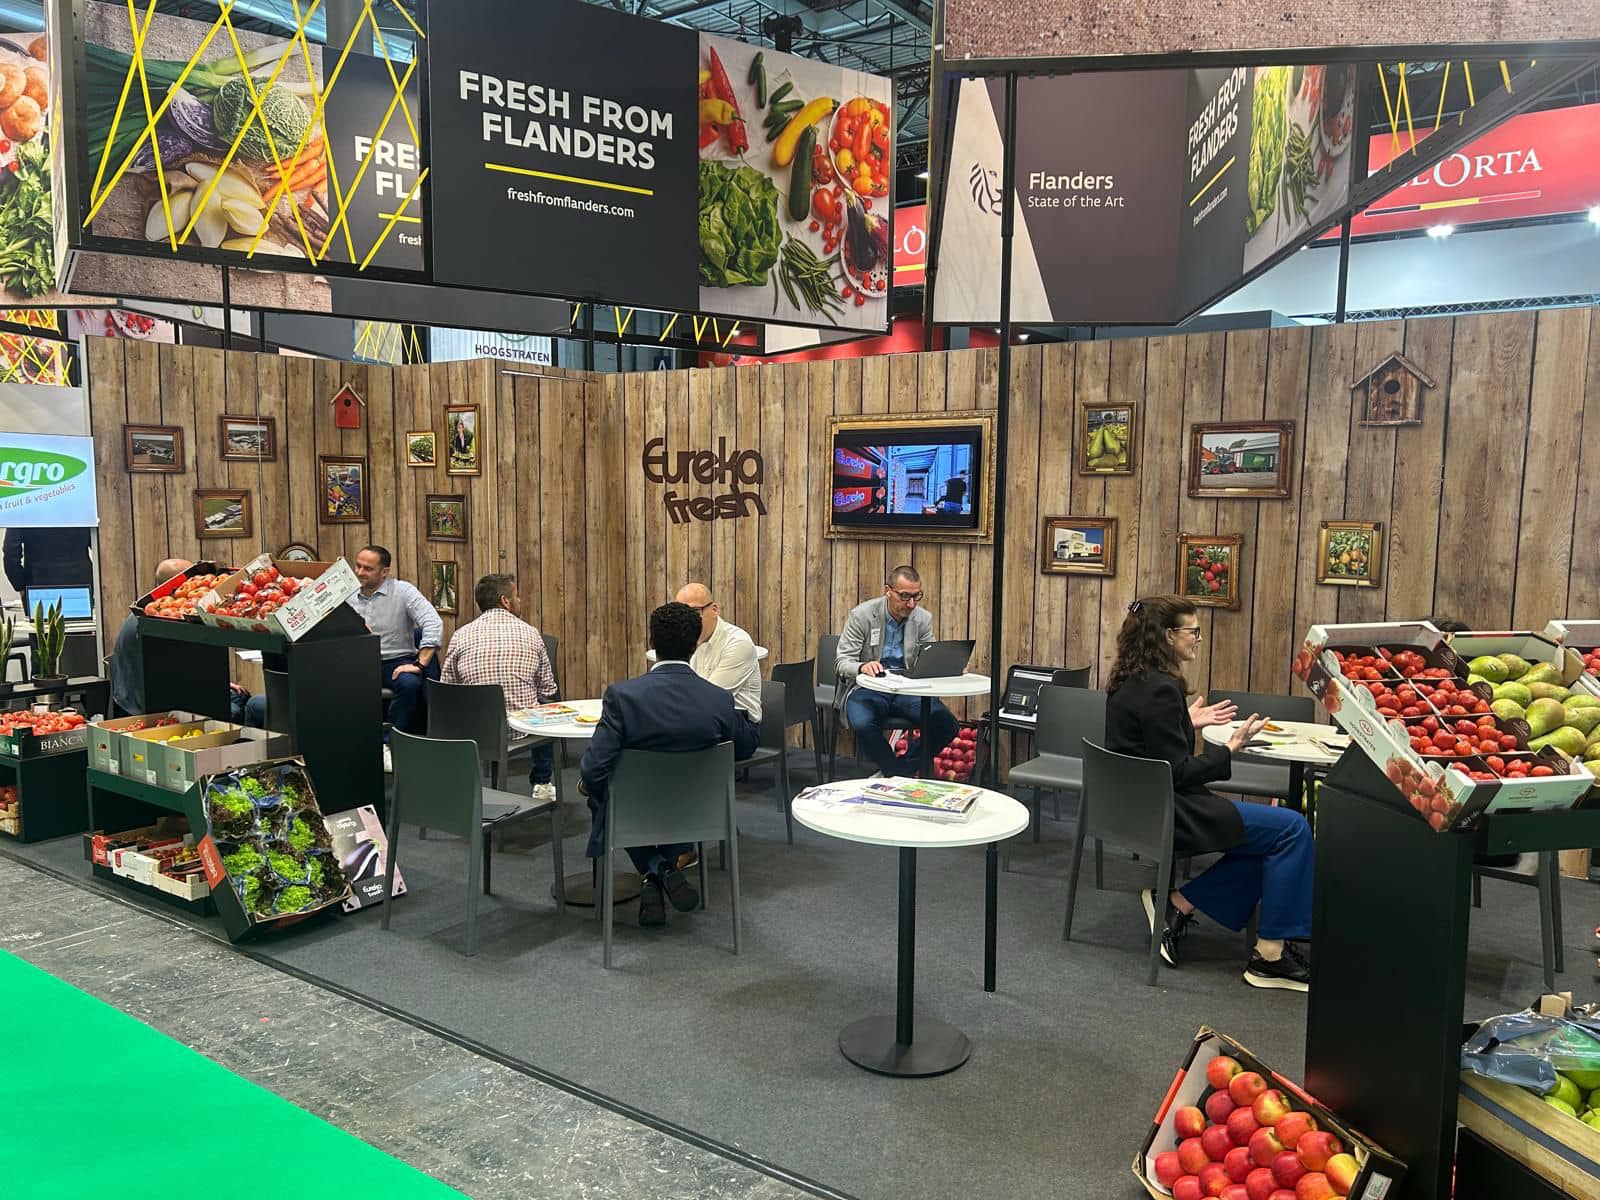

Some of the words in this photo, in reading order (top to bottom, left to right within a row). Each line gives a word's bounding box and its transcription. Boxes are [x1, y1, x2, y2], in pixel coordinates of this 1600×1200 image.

[459, 70, 570, 120] FRESH
[583, 95, 673, 140] FROM
[1188, 97, 1215, 155] FRESH
[1217, 66, 1247, 118] FROM
[354, 135, 420, 170] FRE
[482, 111, 656, 170] FLANDERS
[1191, 102, 1239, 183] FLANDERS
[1029, 171, 1114, 190] Flanders
[507, 187, 634, 218] freshfromflanders.com
[1028, 196, 1060, 208] State
[1063, 195, 1078, 207] of
[1080, 195, 1101, 207] the
[1104, 196, 1125, 207] Art
[475, 343, 550, 363] HOOGSTRATEN
[642, 436, 764, 485] Eureka
[5, 497, 23, 509] fruit
[34, 483, 76, 501] vegetables
[664, 484, 767, 524] fresh
